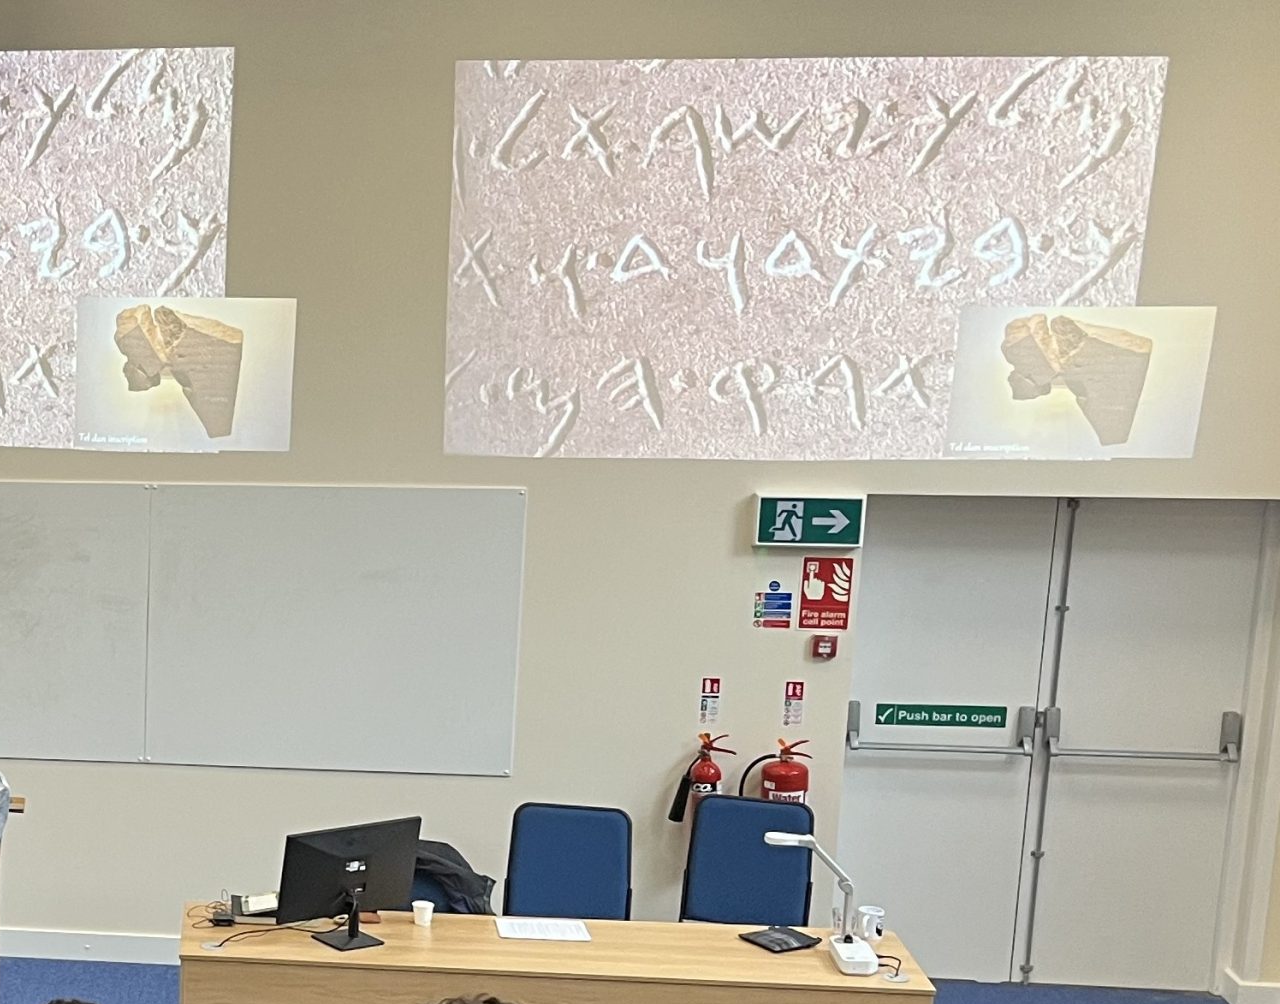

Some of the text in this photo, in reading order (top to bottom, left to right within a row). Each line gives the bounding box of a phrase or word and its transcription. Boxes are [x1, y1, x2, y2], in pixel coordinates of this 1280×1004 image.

[801, 610, 846, 619] Fire alarm
[820, 619, 844, 627] point
[898, 711, 1001, 725] Push bar to open
[772, 793, 801, 803] Water
